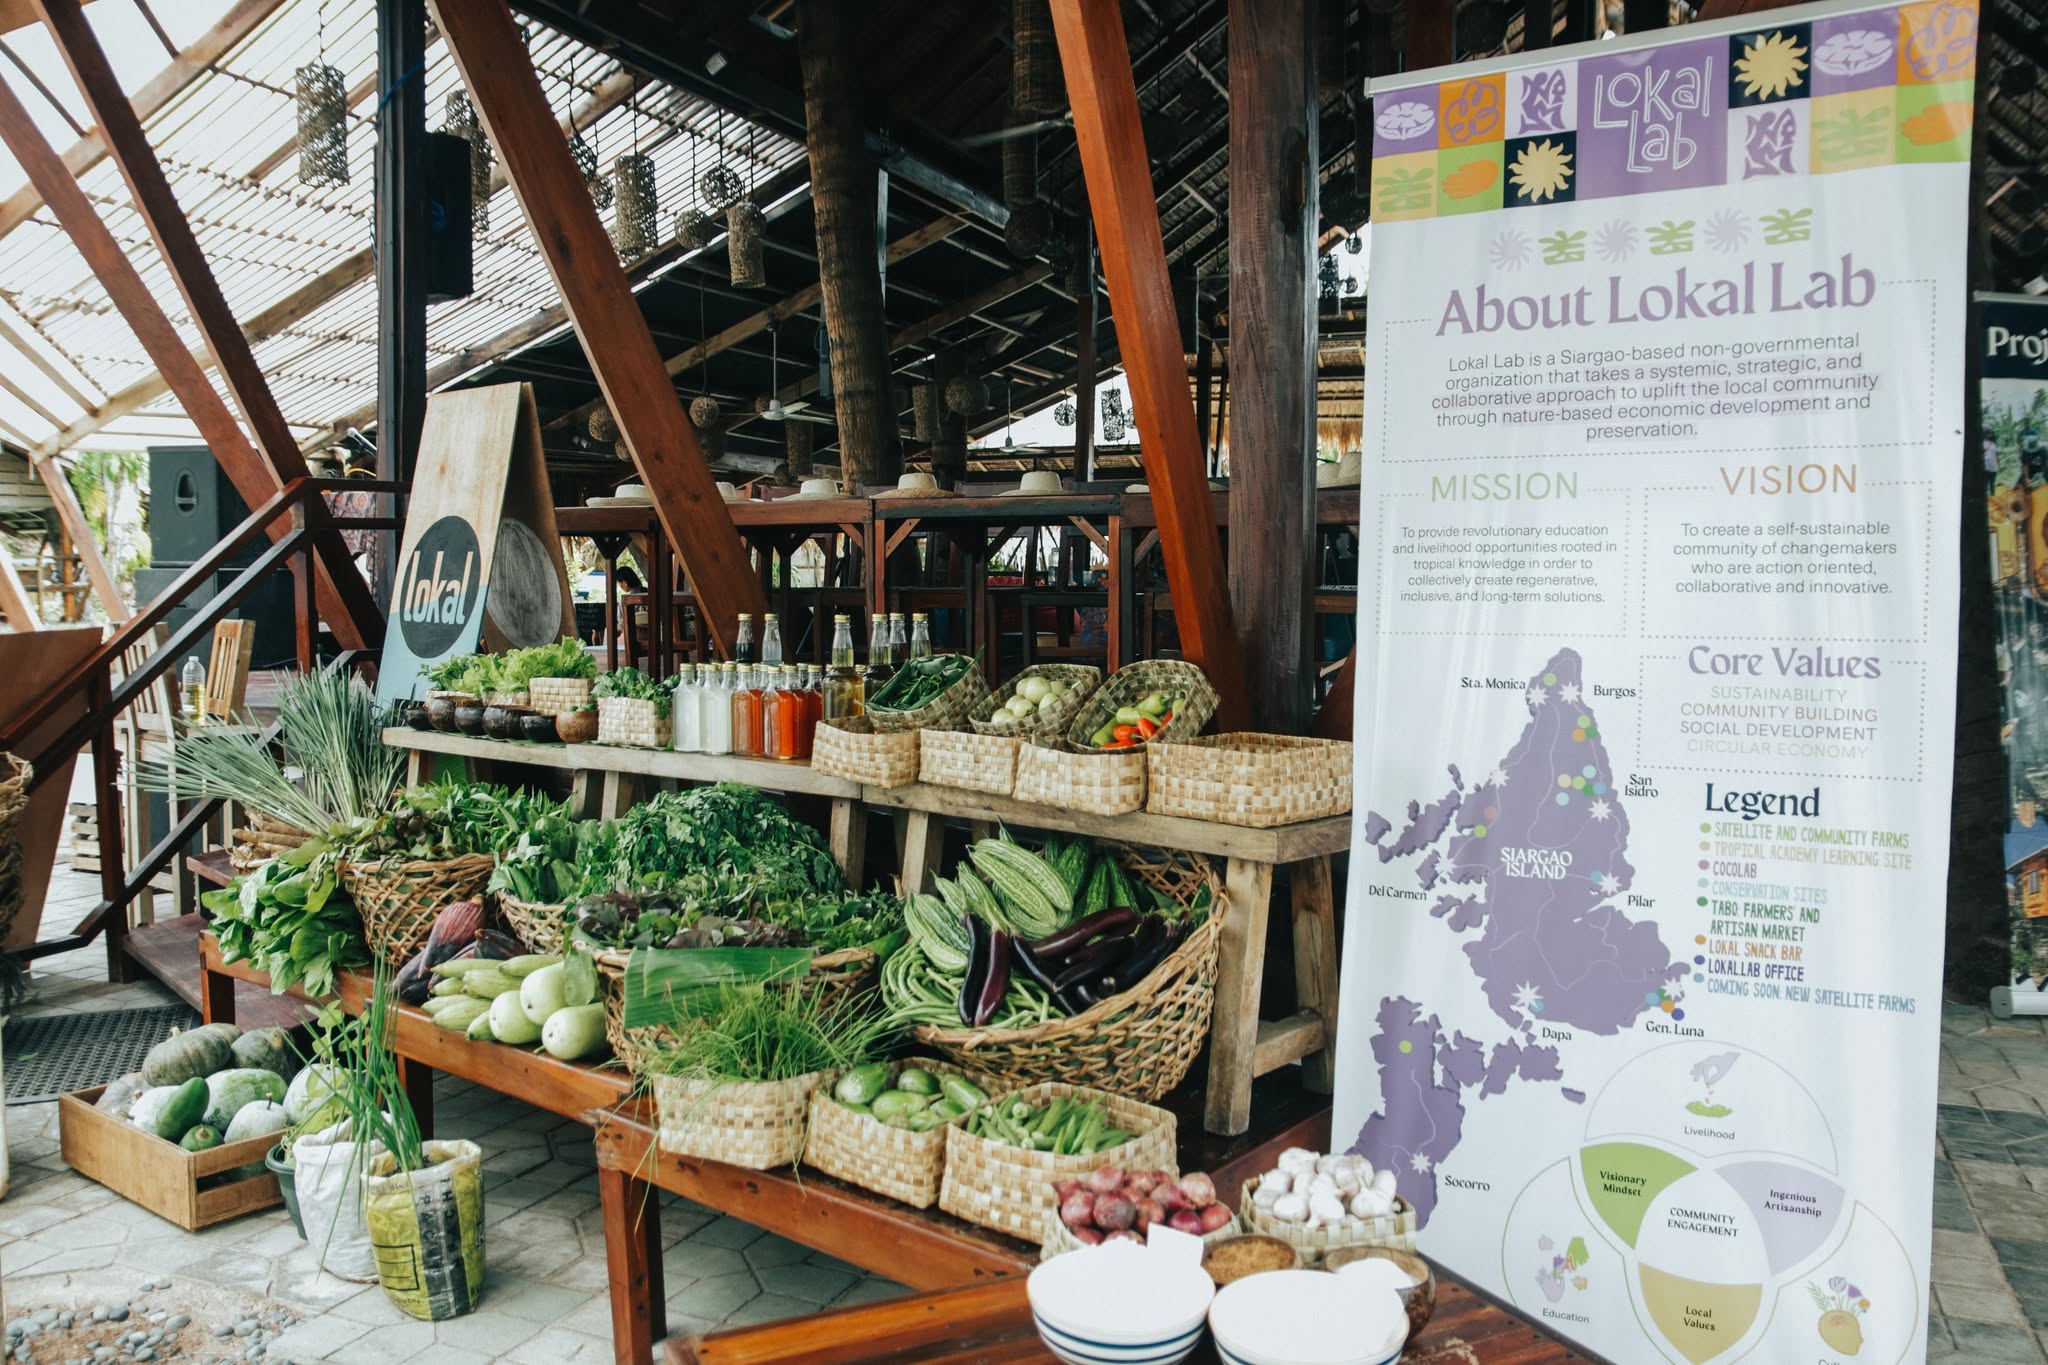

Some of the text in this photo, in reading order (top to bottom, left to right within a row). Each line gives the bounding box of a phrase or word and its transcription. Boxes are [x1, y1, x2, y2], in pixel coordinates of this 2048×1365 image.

[1627, 110, 1697, 172] Lab
[1435, 253, 1876, 336] About Lokal Lab
[1449, 332, 1859, 372] Lokal Lab is a Siargao-based non-governmental
[1446, 353, 1862, 392] organization that takes a systemic, strategic, and
[1432, 373, 1879, 409] collaborative approach to uplift the local community
[1437, 393, 1871, 427] through nature-based economic development and
[1586, 422, 1698, 442] preservation.
[1431, 471, 1578, 502] MISSION
[1719, 463, 1856, 495] VISION
[1401, 525, 1609, 539] To provide revolutionary education
[1681, 521, 1890, 536] To create a self-sustainable
[1392, 541, 1617, 555] and livelihood opportunities rooted in
[1673, 541, 1897, 557] community of changemakers
[1414, 557, 1592, 571] tropical knowledge in order to
[1691, 560, 1877, 575] who are action oriented,
[403, 550, 474, 625] lokal
[1408, 574, 1598, 588] collectively create regenerative,
[1675, 580, 1892, 594] collaborative and innovative.
[1400, 590, 1606, 604] inclusive, and long-term solutions.
[1688, 645, 1881, 679] Core Values
[1461, 677, 1526, 690] Sta. Monica
[1593, 685, 1636, 699] Burgos
[1711, 686, 1847, 702] SUSTAINABILITY
[1680, 703, 1878, 722] COMMUNITY BUILDING
[1680, 721, 1877, 740] SOCIAL DEVELOPMENT
[1687, 739, 1868, 759] CIRCULAR ECONOMY
[1629, 774, 1652, 786] San
[1624, 785, 1658, 798] Isidro
[1705, 782, 1820, 821] Legend
[1714, 822, 1909, 849] SATELLITE AND COMMUNITY FARMS
[1501, 847, 1573, 866] SIARGAO
[1715, 841, 1912, 870] TROPICAL ACADEMY LEARNING SITE
[1506, 862, 1566, 880] ISLAND
[1713, 861, 1757, 879] COCOLAB
[1369, 884, 1427, 901] Del Carmen
[1627, 895, 1655, 907] Pilar
[1712, 880, 1828, 904] CONSERVATION SITES
[1799, 907, 1820, 924] AND
[1710, 919, 1805, 942] ARTISAN MARKET
[1709, 939, 1803, 961] LOKAL SNACK BAR
[1765, 964, 1804, 982] OFFICE
[1707, 978, 1749, 996] COMING
[1785, 986, 1810, 1003] NEW
[1815, 988, 1874, 1009] SATELLITE
[1878, 994, 1915, 1014] FARMS
[1542, 1027, 1572, 1042] Dapa
[1646, 1021, 1705, 1037] Gen. Luna
[1684, 1125, 1736, 1140] Livelihood
[1445, 1175, 1490, 1192] Socorro
[1599, 1170, 1647, 1187] Visionary
[1603, 1183, 1642, 1197] Mindset
[1770, 1189, 1817, 1204] Ingenious
[1669, 1207, 1736, 1225] COMMUNITY
[1764, 1200, 1822, 1218] Artisanship
[1667, 1219, 1739, 1237] ENGAGEMENT
[1542, 1308, 1590, 1324] Education
[1685, 1305, 1712, 1319] Local
[1683, 1317, 1716, 1331] Values
